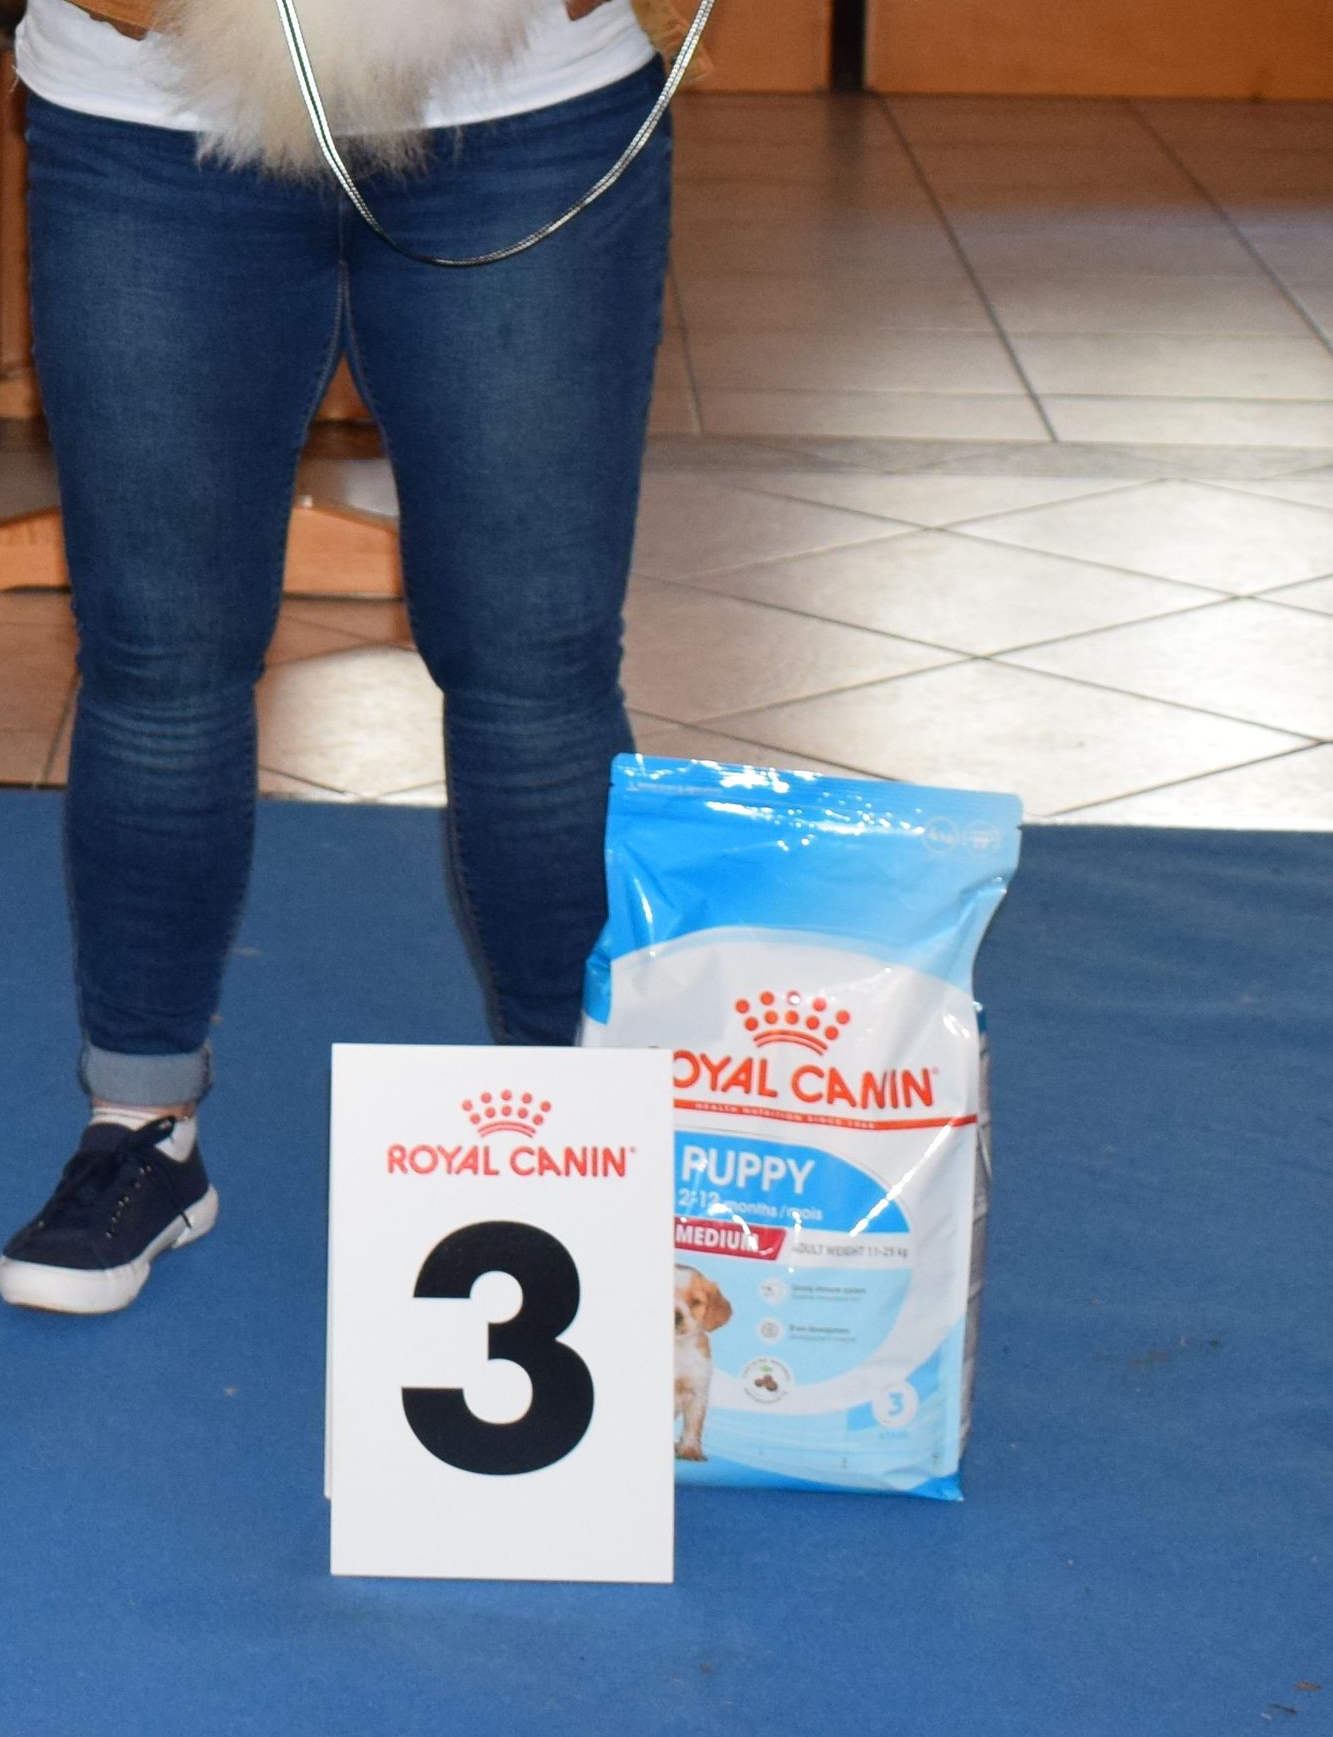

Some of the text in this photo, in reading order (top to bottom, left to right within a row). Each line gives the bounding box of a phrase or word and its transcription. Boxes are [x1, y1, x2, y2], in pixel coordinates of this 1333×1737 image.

[673, 1049, 934, 1110] OYAL CANIN
[387, 1143, 627, 1178] ROYAL CANIN
[682, 1144, 816, 1195] PUPPY
[674, 1224, 760, 1254] MEDIUM
[399, 1219, 596, 1476] 3
[887, 1391, 905, 1416] 3
